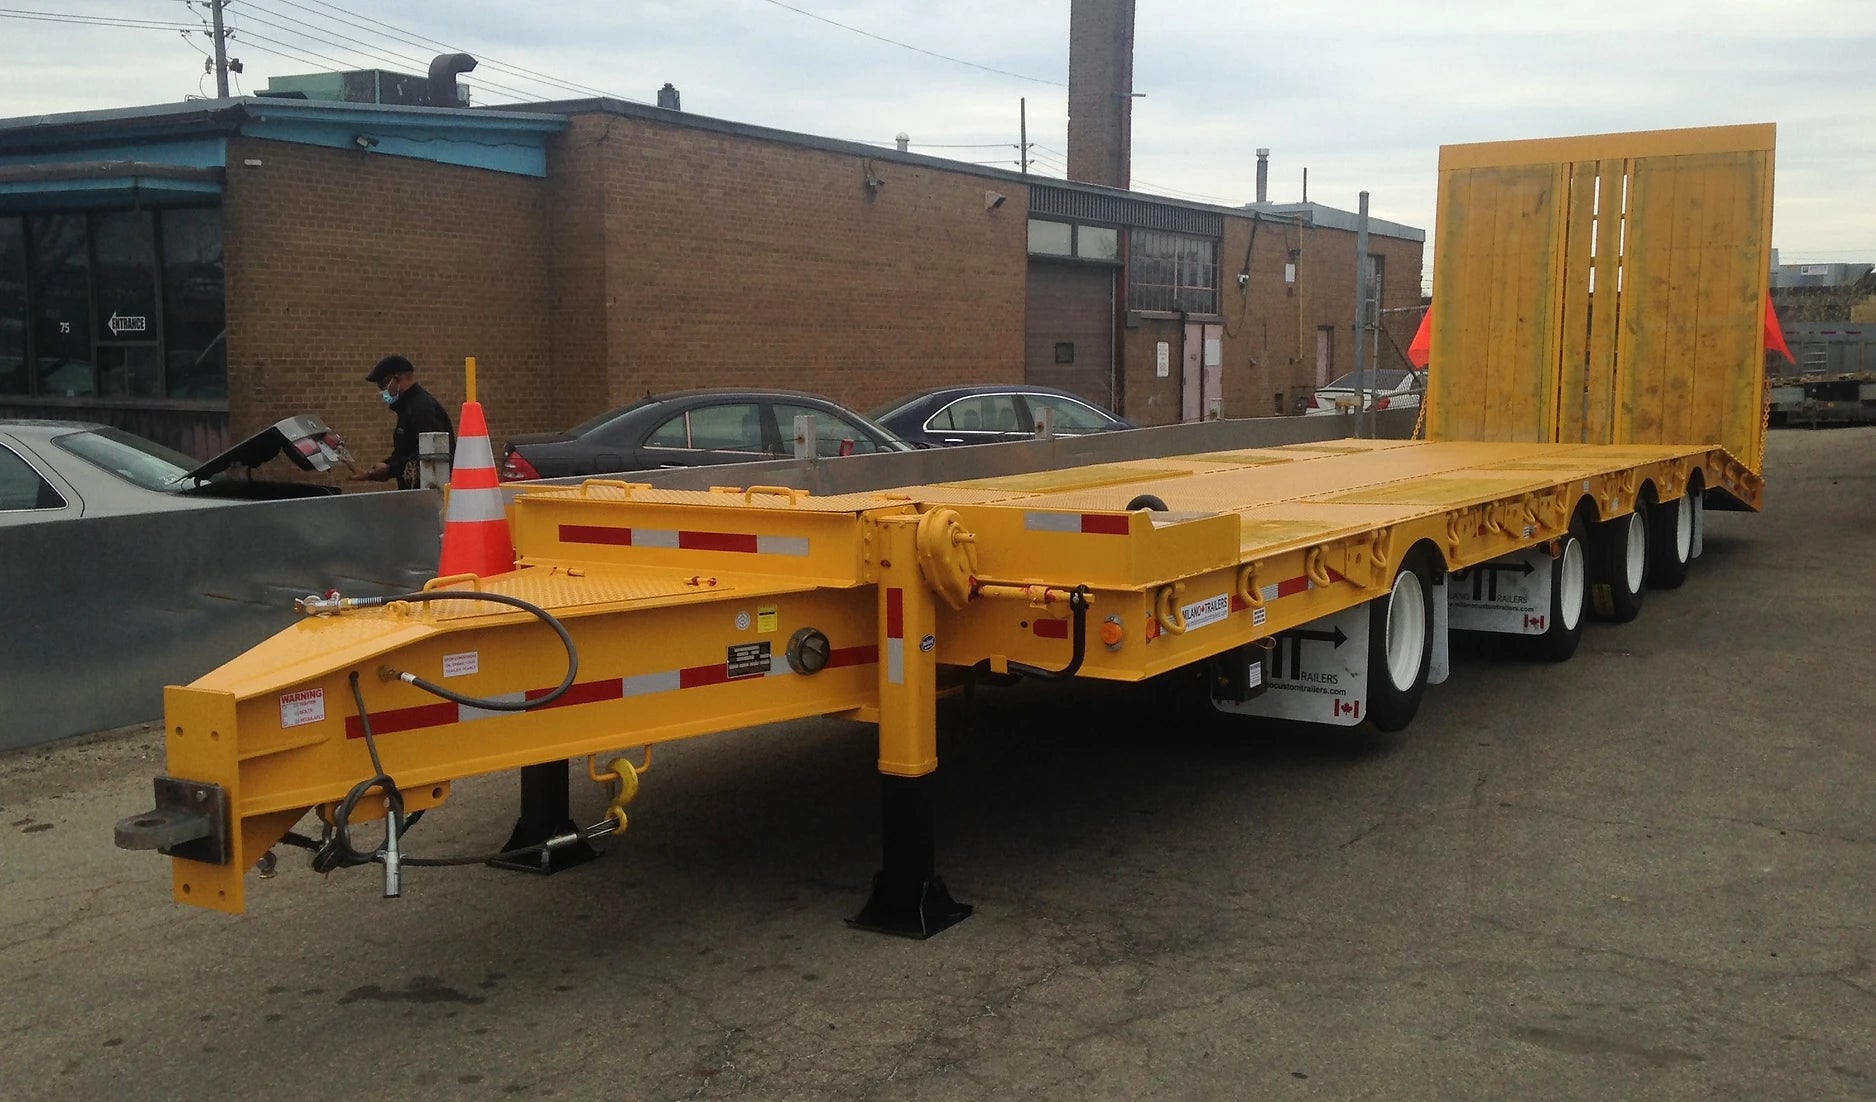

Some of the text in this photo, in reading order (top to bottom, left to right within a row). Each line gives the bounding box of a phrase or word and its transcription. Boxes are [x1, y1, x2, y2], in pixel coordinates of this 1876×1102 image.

[60, 322, 70, 333] 75
[112, 317, 145, 330] ENTRANCE
[1182, 603, 1201, 620] MILANO
[1204, 597, 1228, 614] TRAILERS
[280, 689, 322, 704] WARNING
